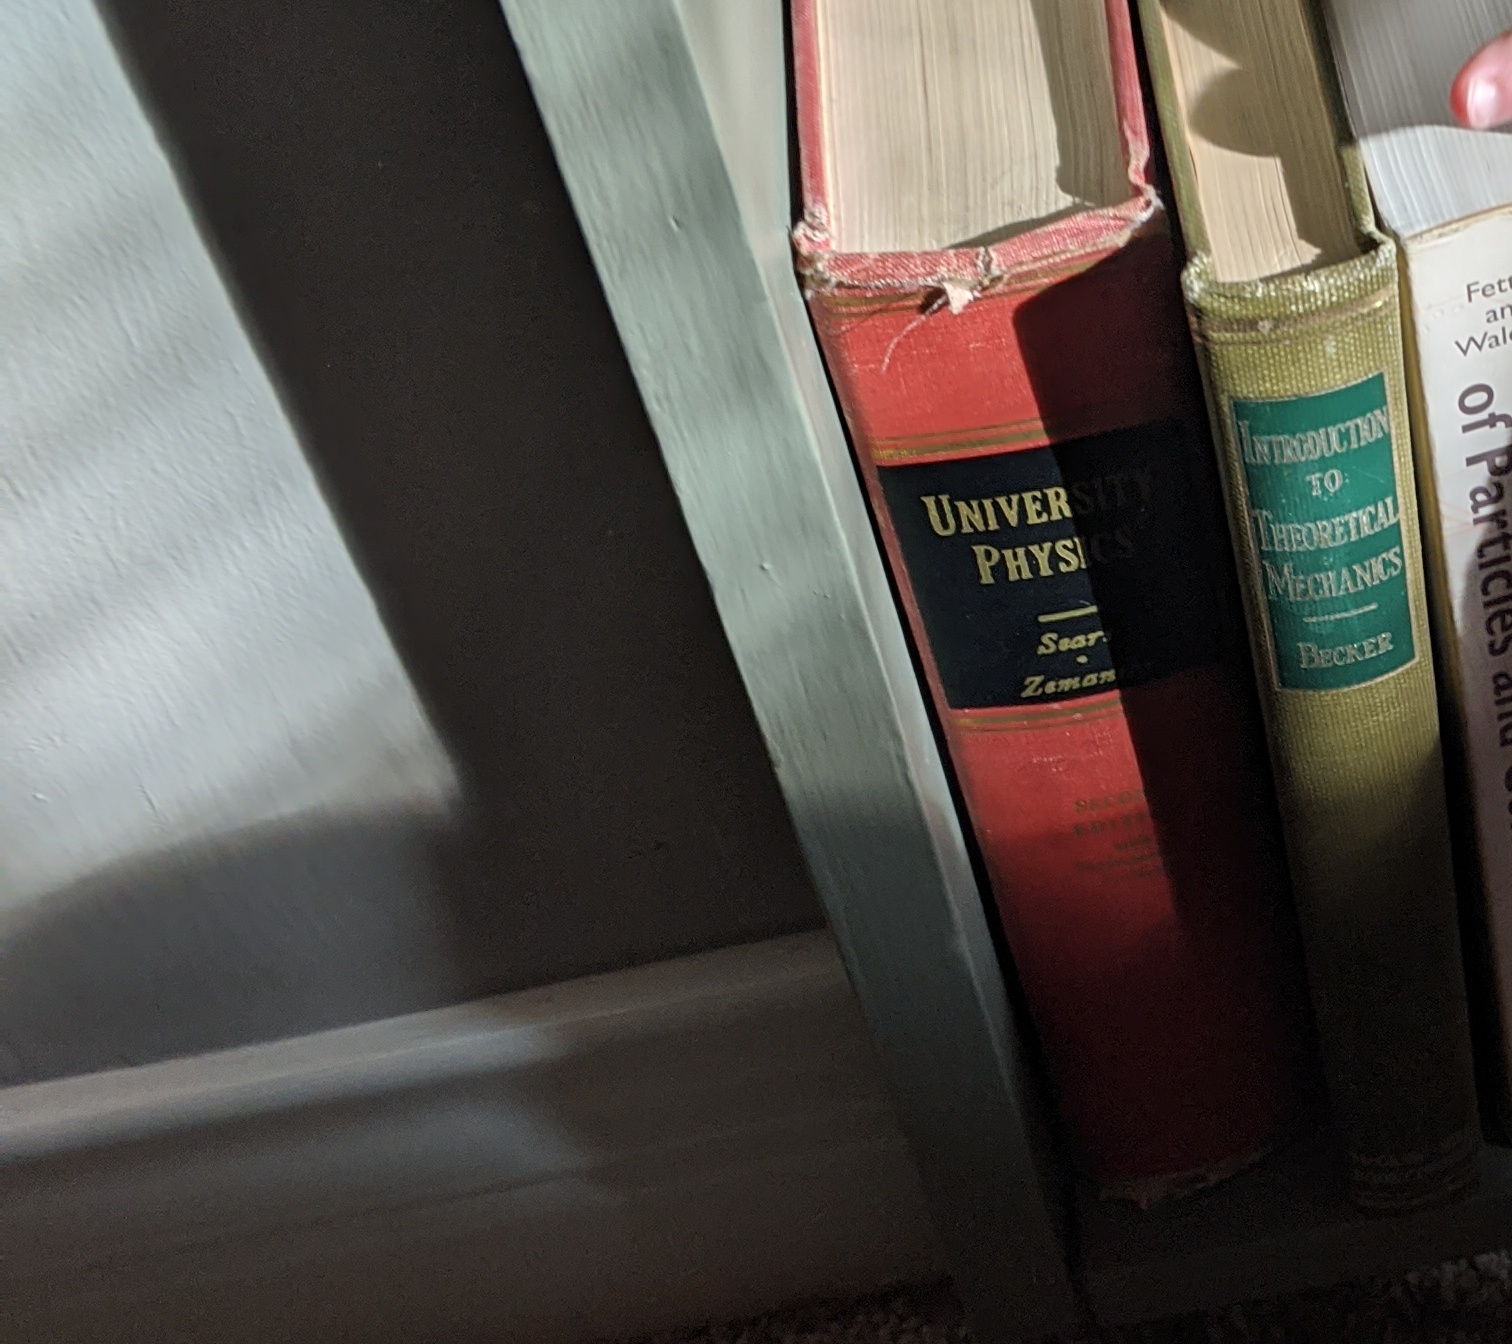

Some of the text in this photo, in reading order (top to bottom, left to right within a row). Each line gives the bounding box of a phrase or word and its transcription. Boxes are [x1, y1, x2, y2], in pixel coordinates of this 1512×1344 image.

[1237, 405, 1391, 465] INTRODUCTION
[1305, 469, 1344, 497] TO
[1252, 495, 1401, 552] THEORETICAL
[1262, 544, 1403, 603] MECHANICS
[1296, 630, 1395, 669] BECKER
